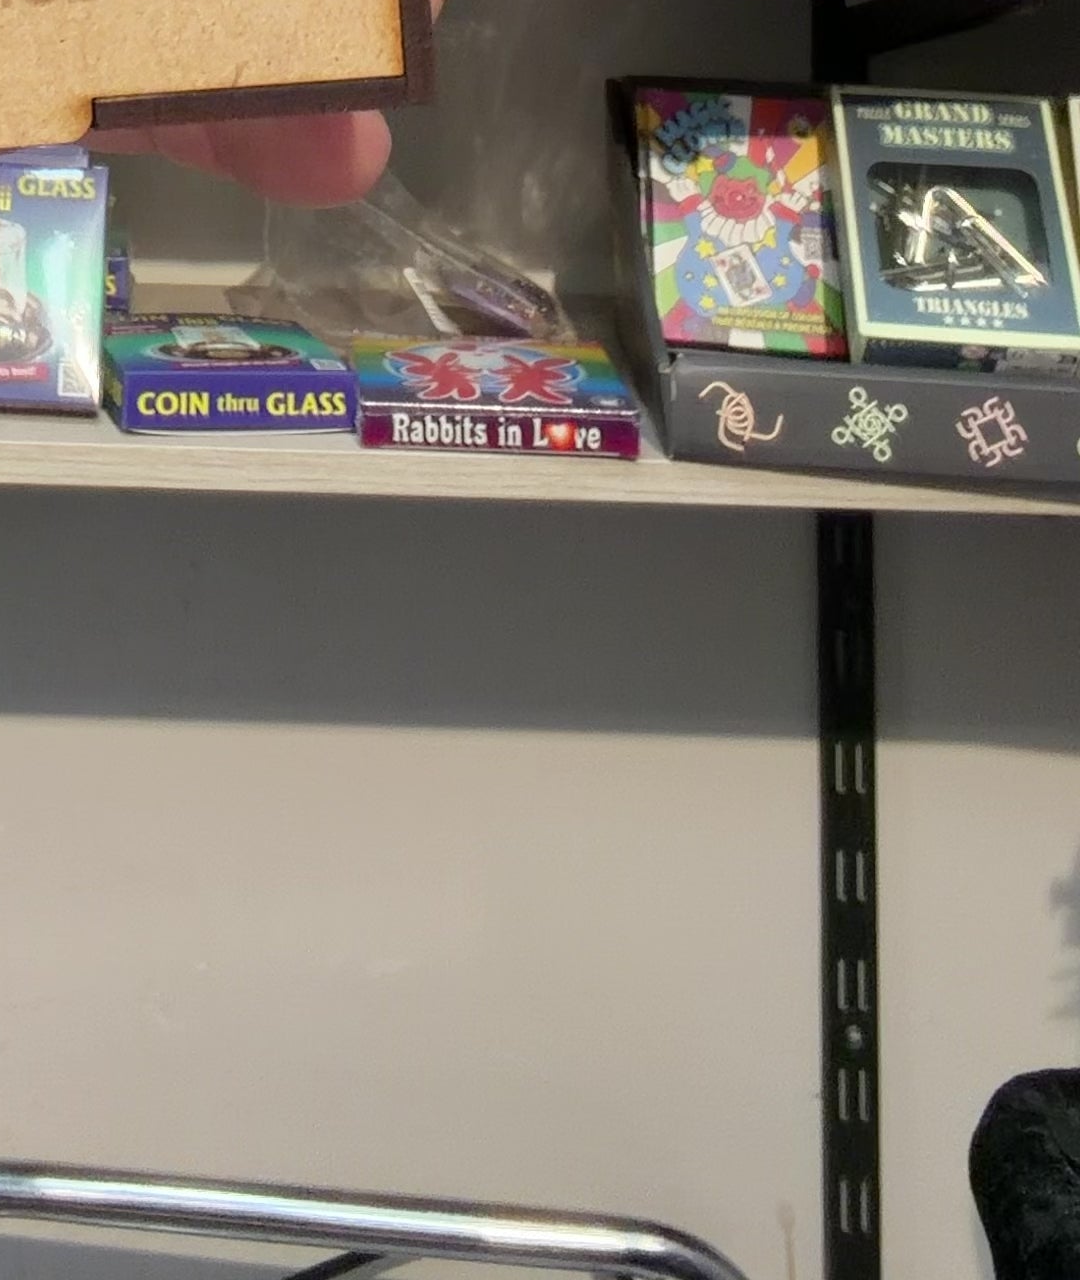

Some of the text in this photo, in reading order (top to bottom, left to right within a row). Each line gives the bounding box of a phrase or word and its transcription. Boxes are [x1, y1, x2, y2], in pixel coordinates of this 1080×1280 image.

[894, 101, 993, 124] GRAND
[880, 123, 1016, 153] MASTERS
[17, 175, 96, 199] GLASS
[913, 296, 1029, 319] TRIANGLES
[137, 390, 346, 417] COIN thru GLASS
[392, 412, 488, 446] Rabbits
[498, 415, 522, 447] in
